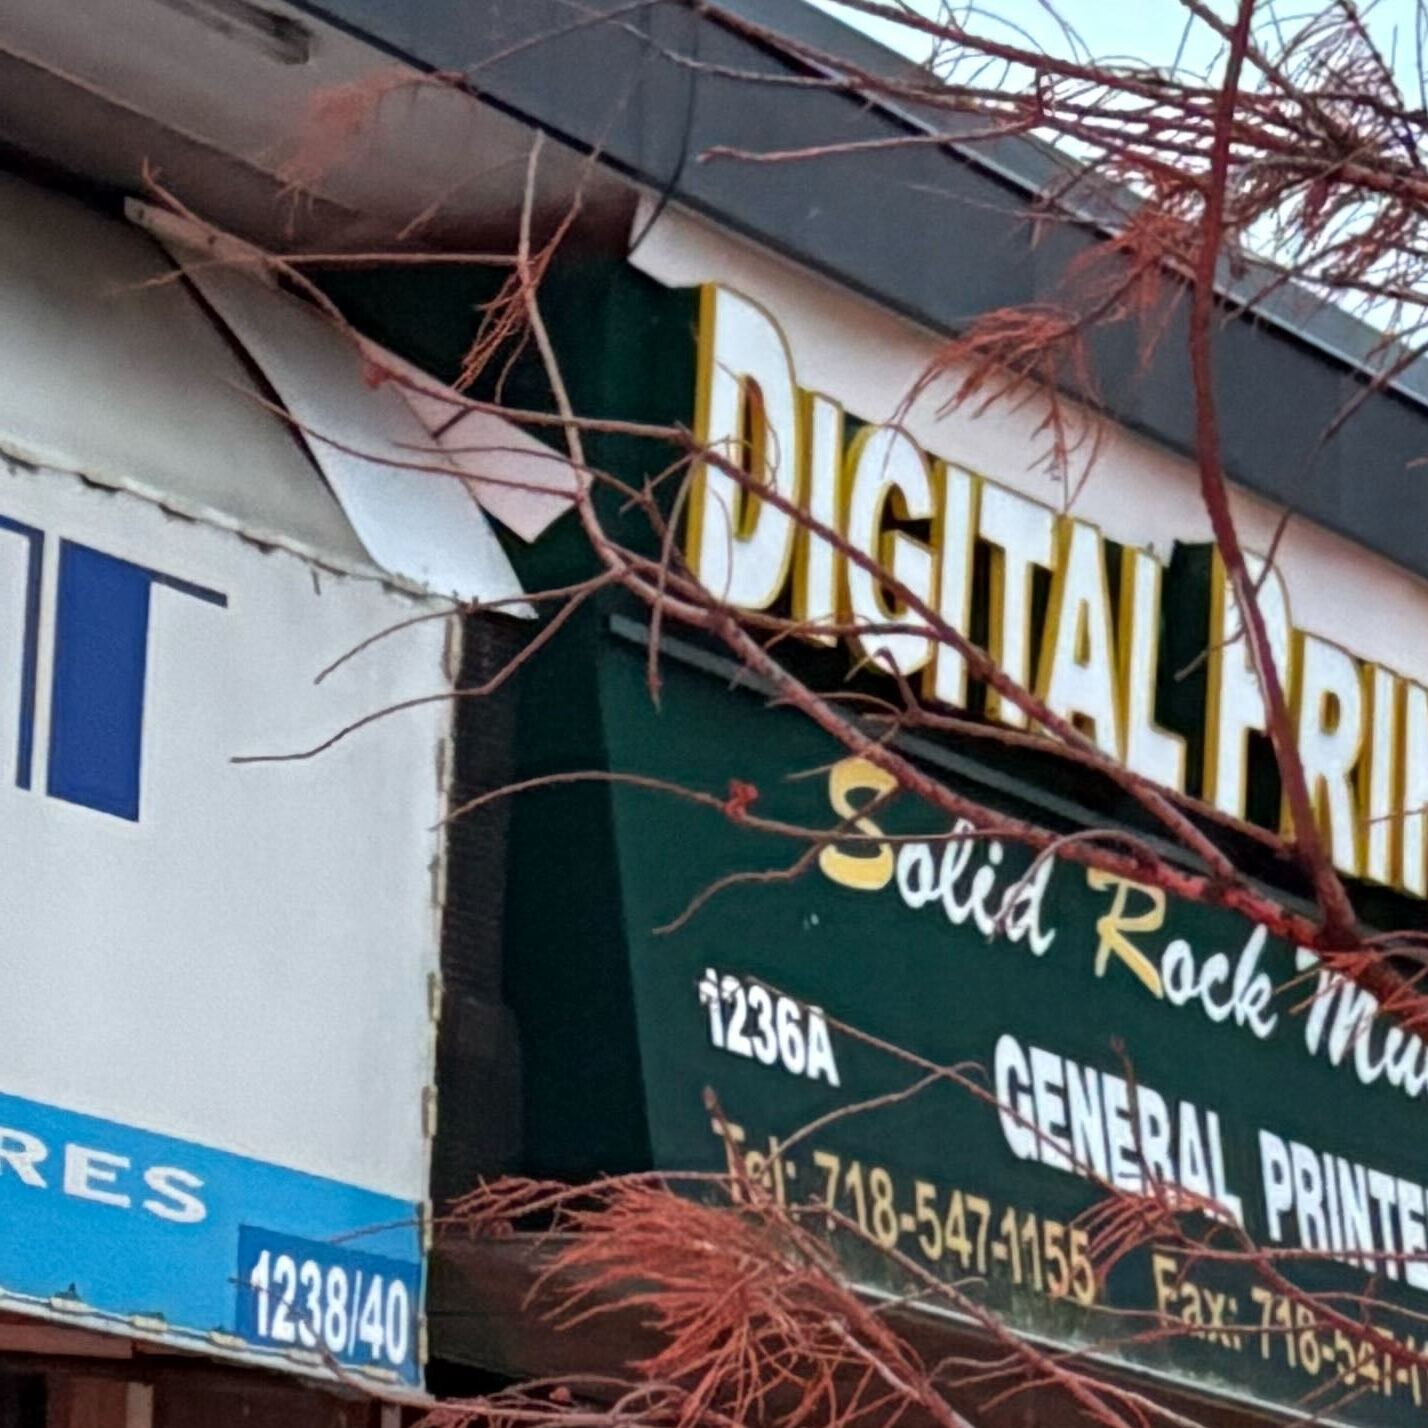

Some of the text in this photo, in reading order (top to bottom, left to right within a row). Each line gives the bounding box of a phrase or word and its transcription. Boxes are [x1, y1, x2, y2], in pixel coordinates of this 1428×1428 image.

[690, 281, 1190, 793] DIGITAL
[819, 757, 1056, 957] Solid
[1087, 866, 1280, 1040] Rock
[697, 968, 841, 1088] 1236A
[994, 1034, 1245, 1230] GENERAL
[251, 1250, 409, 1365] 1238/40
[815, 1151, 1097, 1304] 718-547-1155
[1151, 1254, 1242, 1350] Fax:
